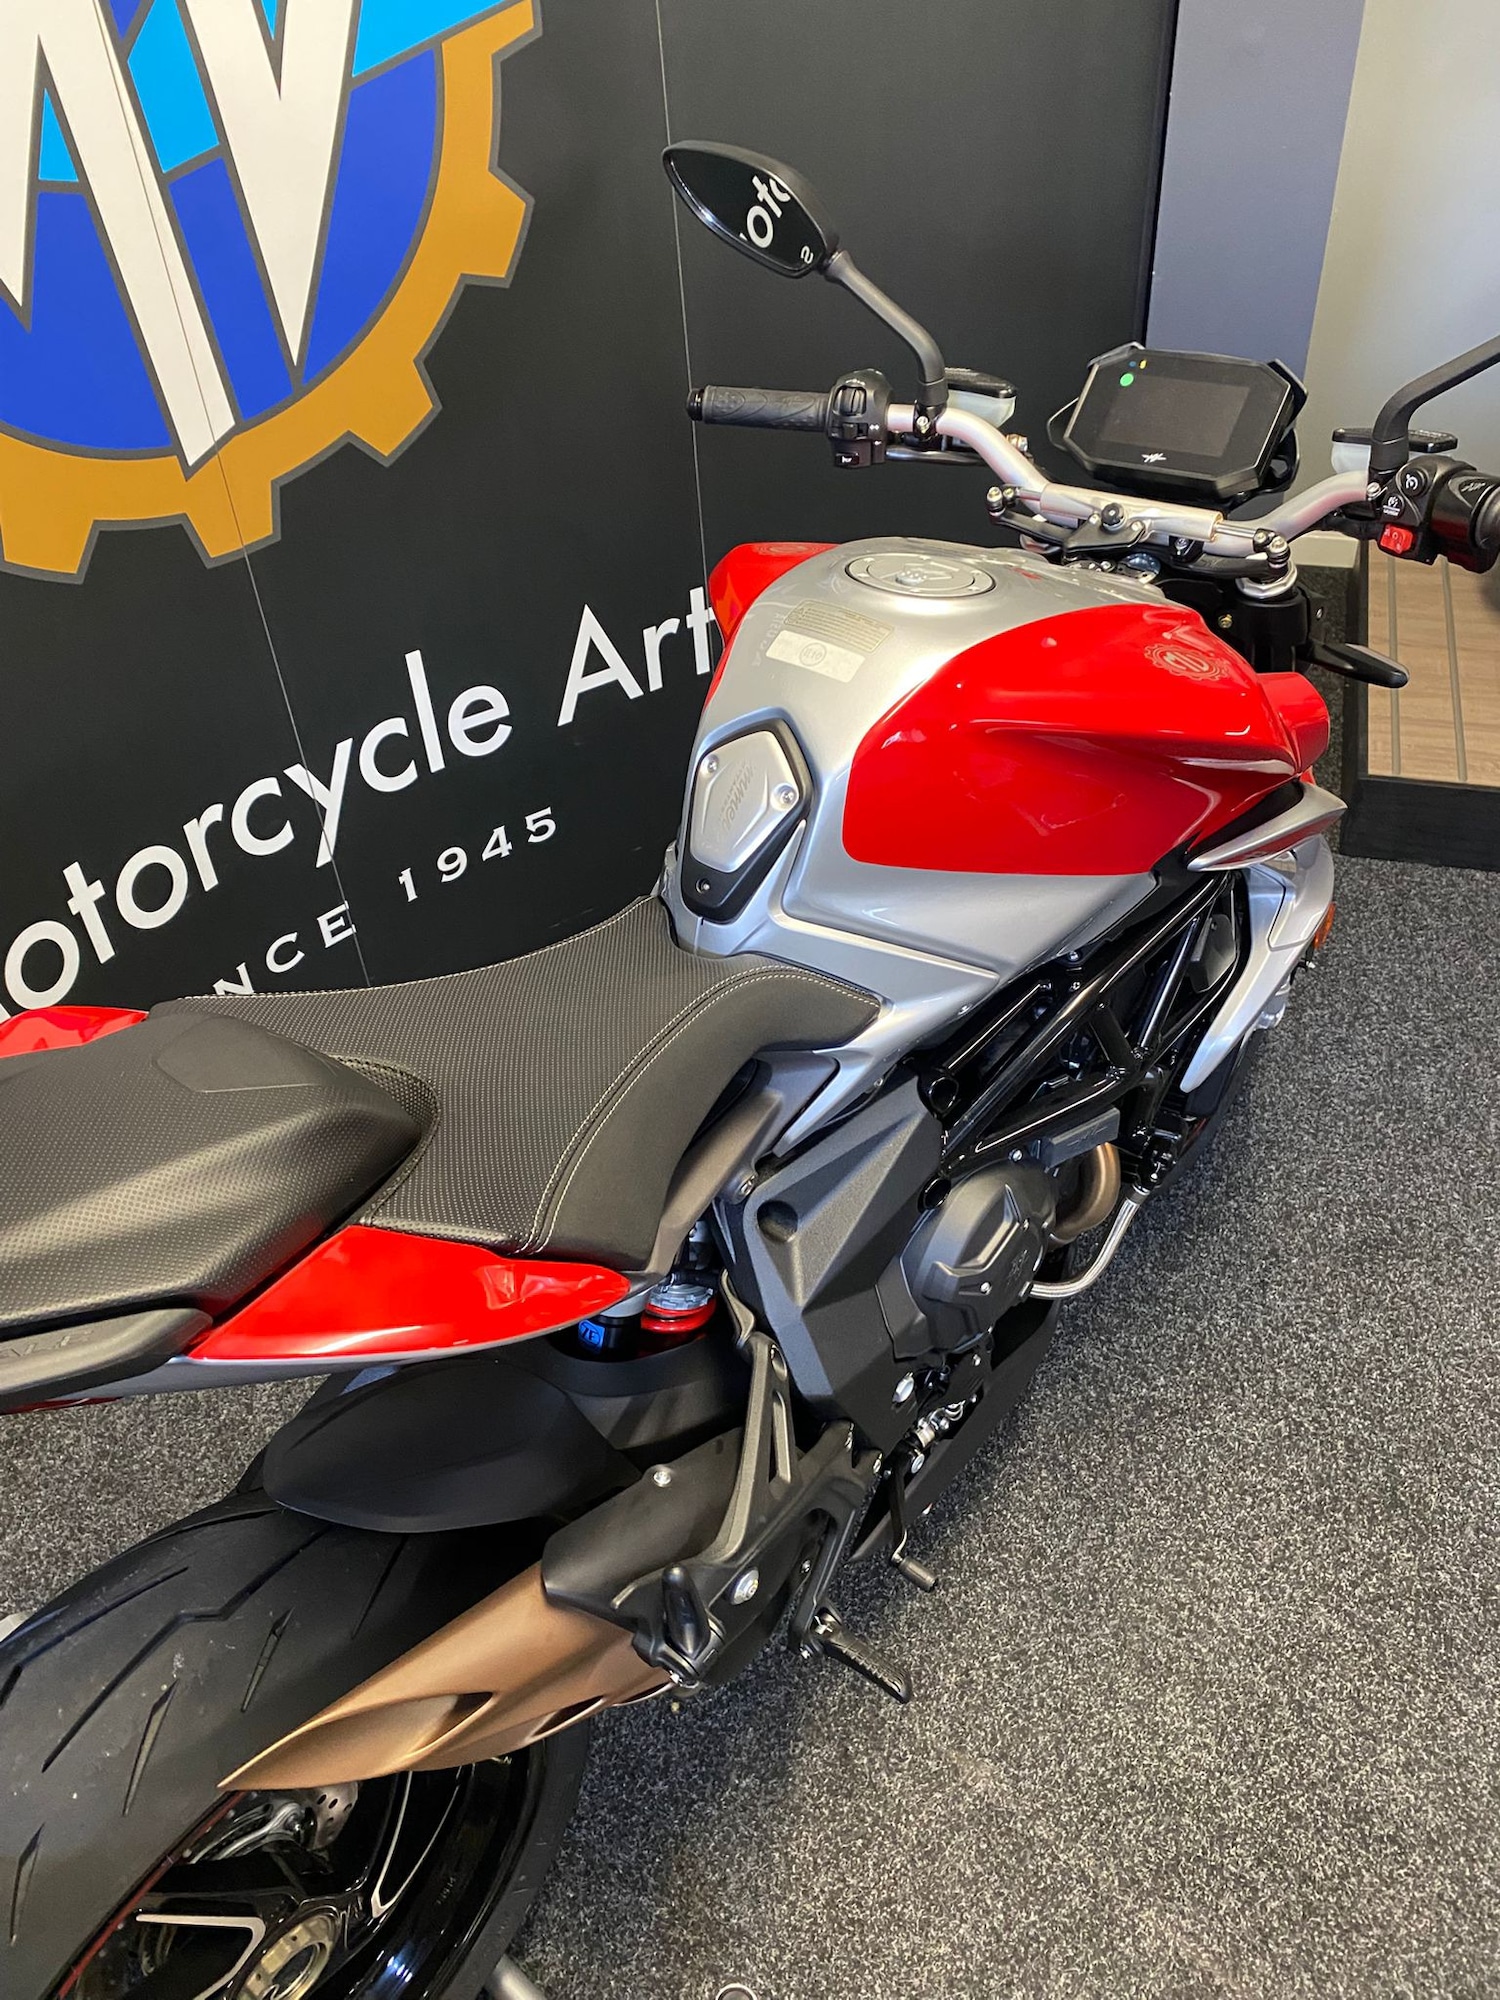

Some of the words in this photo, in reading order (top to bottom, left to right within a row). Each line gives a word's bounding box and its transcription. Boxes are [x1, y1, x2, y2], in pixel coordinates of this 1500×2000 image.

[0, 649, 513, 1023] otorcycle
[557, 586, 716, 727] Art
[398, 806, 556, 902] 1945
